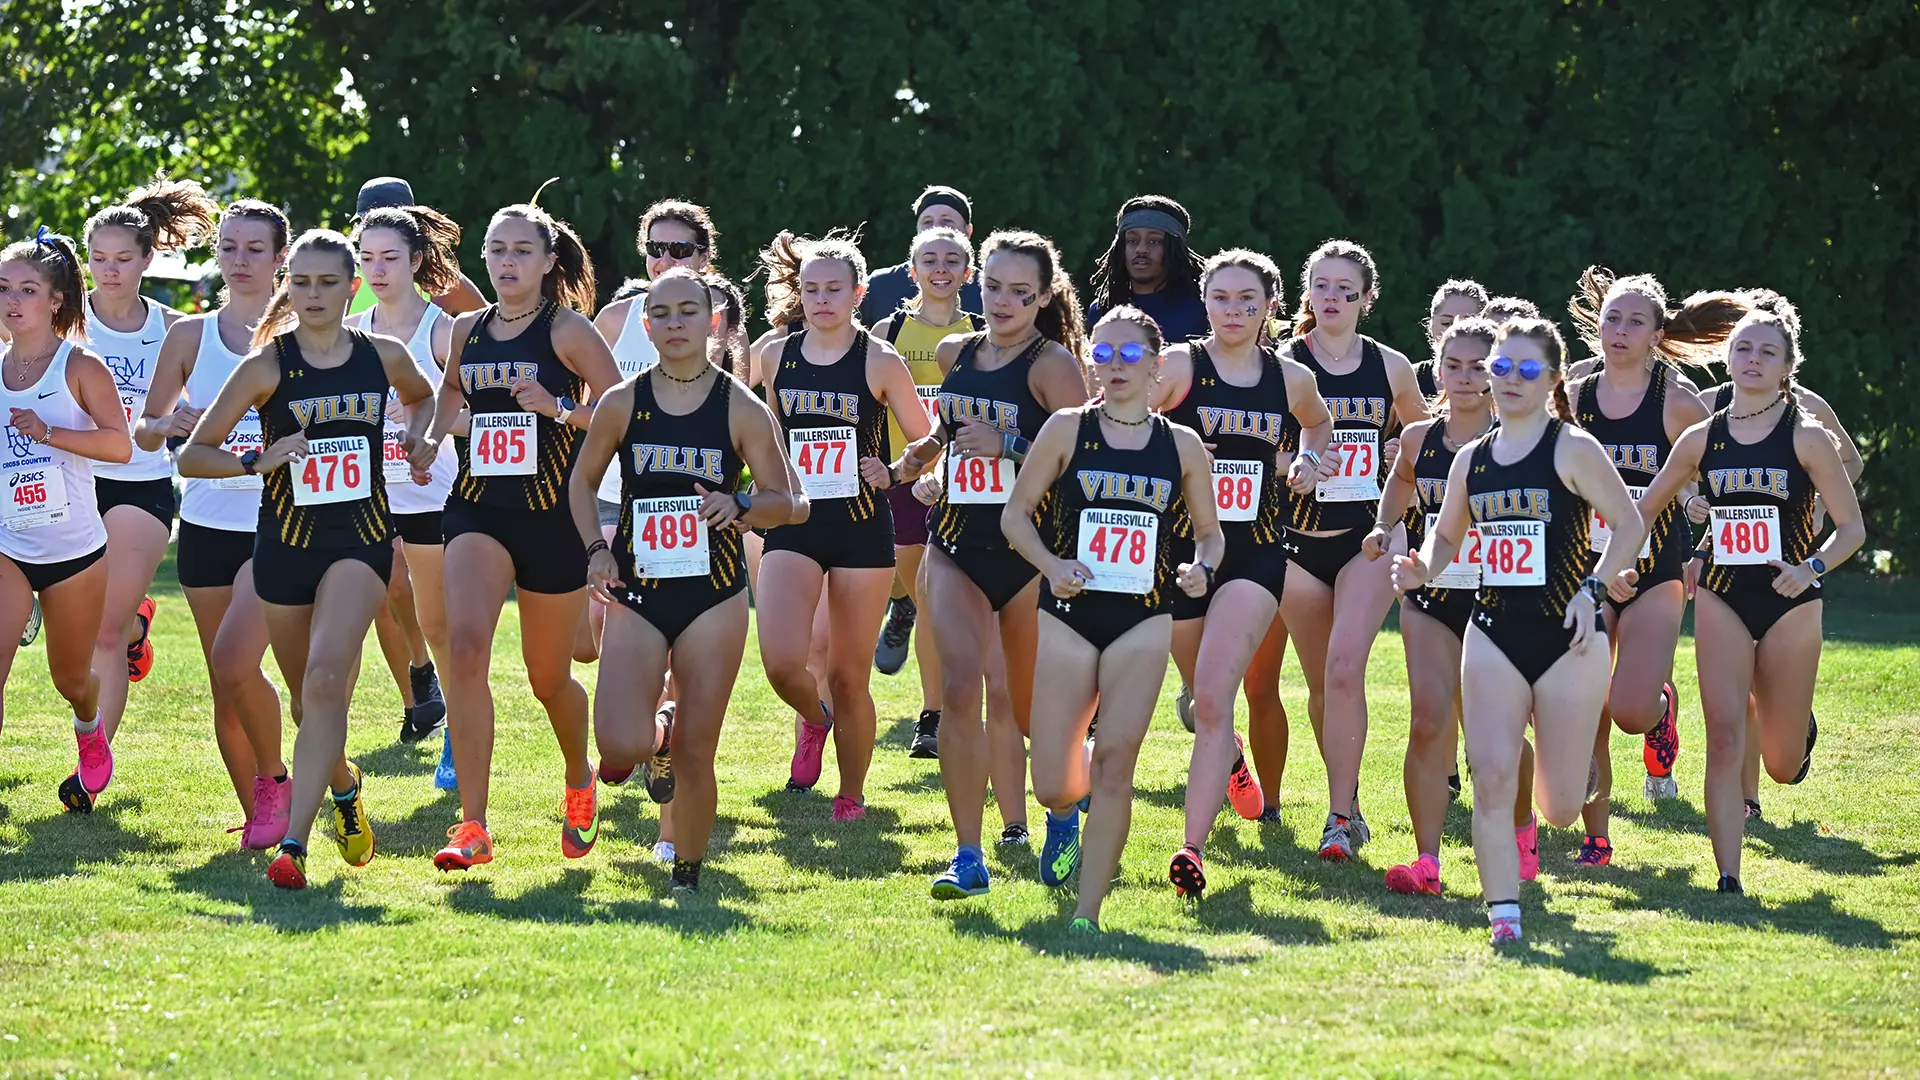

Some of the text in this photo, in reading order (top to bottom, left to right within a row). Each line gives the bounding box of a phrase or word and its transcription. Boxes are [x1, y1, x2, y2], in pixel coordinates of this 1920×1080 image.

[117, 386, 148, 395] COUNTR
[459, 362, 538, 394] VILLE
[289, 393, 381, 429] VILLE
[475, 415, 532, 429] MILLERSVILLE
[779, 388, 860, 424] VILLE
[938, 392, 1021, 436] VILLE
[1322, 397, 1386, 428] ILLE
[793, 429, 852, 442] MILLERSVILLE
[1197, 406, 1282, 446] VILLE
[1330, 432, 1376, 443] LLERSVILLE
[2, 456, 51, 469] CROSS COUNTRY
[308, 439, 364, 455] LERSVILLE
[384, 443, 407, 460] 56
[477, 429, 526, 465] 485
[798, 441, 847, 475] 477
[1333, 444, 1372, 477] 73
[1601, 445, 1659, 475] LLE
[302, 453, 360, 493] 476
[632, 444, 724, 484] VILLE
[954, 457, 1003, 493] 481
[1211, 462, 1259, 475] LERSVILLE
[13, 482, 47, 506] 455
[1077, 470, 1172, 513] VILLE
[1216, 476, 1253, 510] 88
[1708, 468, 1789, 500] VILLE
[638, 499, 701, 514] MILLERSVILLE
[1087, 511, 1154, 528] MILLERSVILLE
[1469, 488, 1552, 522] VILLE
[1715, 508, 1774, 520] MILLERSVILLE
[642, 513, 698, 550] 489
[1089, 526, 1146, 565] 478
[1481, 524, 1539, 537] MILLERSVILLE
[1720, 521, 1769, 554] 480
[1487, 538, 1533, 574] 482
